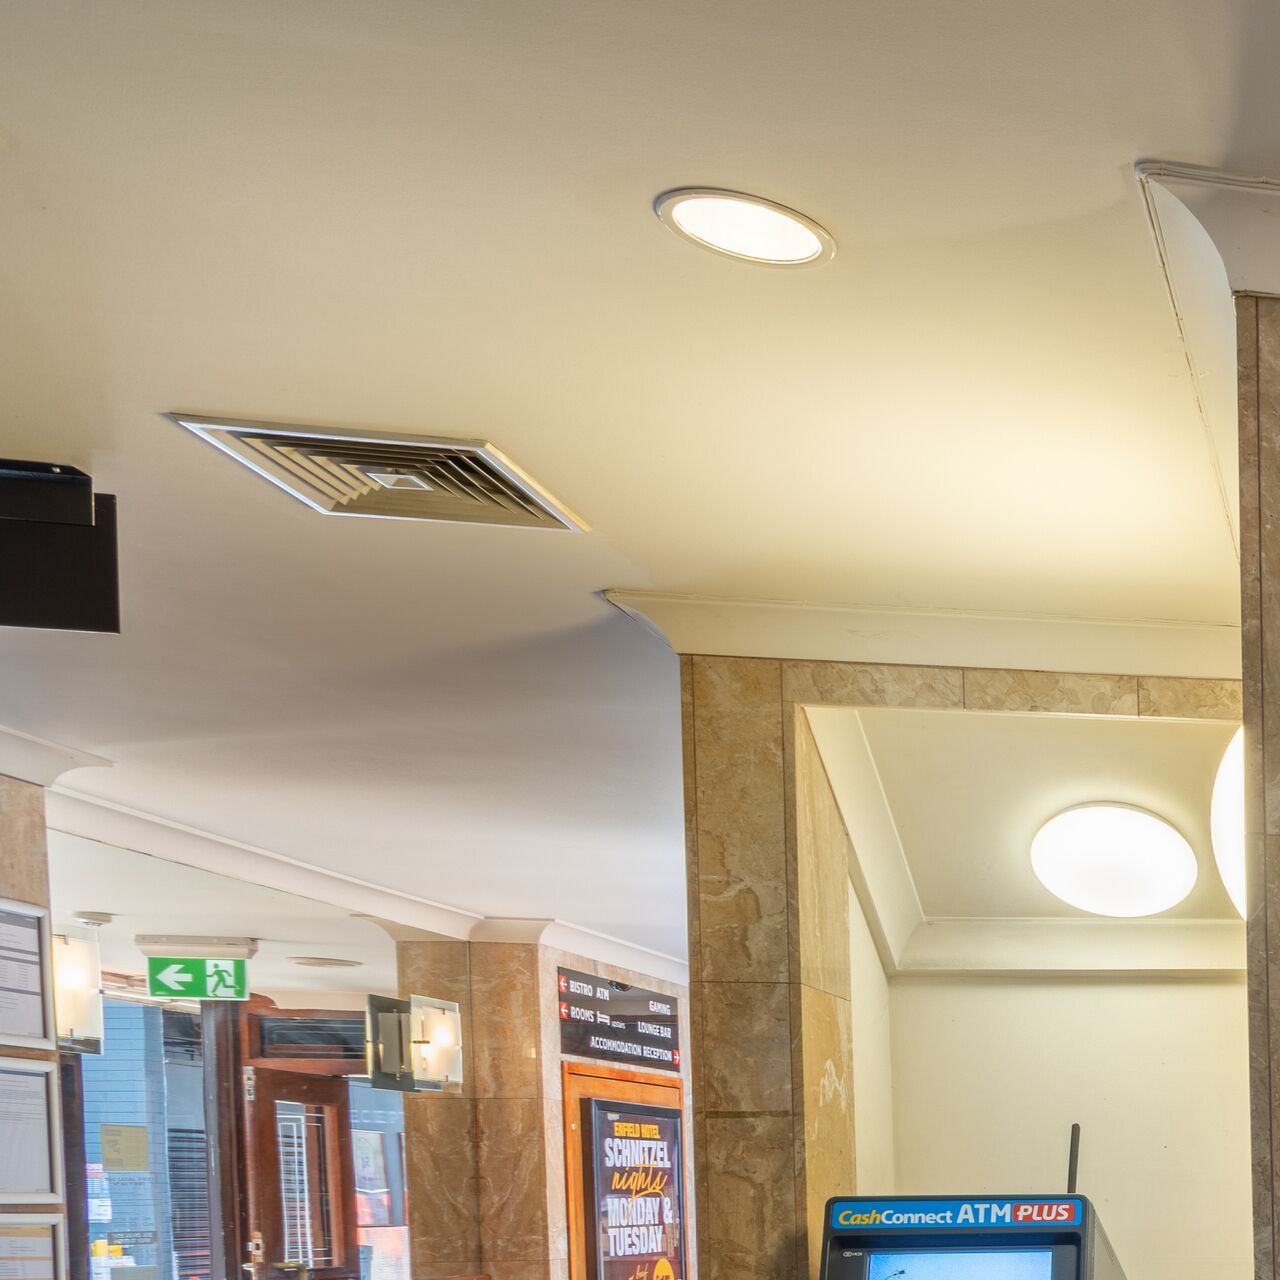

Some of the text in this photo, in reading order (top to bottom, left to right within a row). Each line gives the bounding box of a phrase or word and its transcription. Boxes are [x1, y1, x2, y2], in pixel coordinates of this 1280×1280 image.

[569, 980, 610, 1001] BISTRO ATM
[570, 1006, 595, 1022] ROOMS
[648, 1000, 671, 1015] GAMING
[637, 1021, 672, 1038] LOUNGE BAR
[590, 1036, 672, 1061] ACCOMMODATION RECEPTION
[613, 1122, 661, 1139] ENFIELD HOTEL
[604, 1137, 671, 1168] SCHNITZEL
[611, 1164, 668, 1198] nights
[607, 1196, 674, 1227] MONDAY &
[838, 1203, 1070, 1225] CashConnect ATM PLUS
[607, 1226, 663, 1257] TUESDAY
